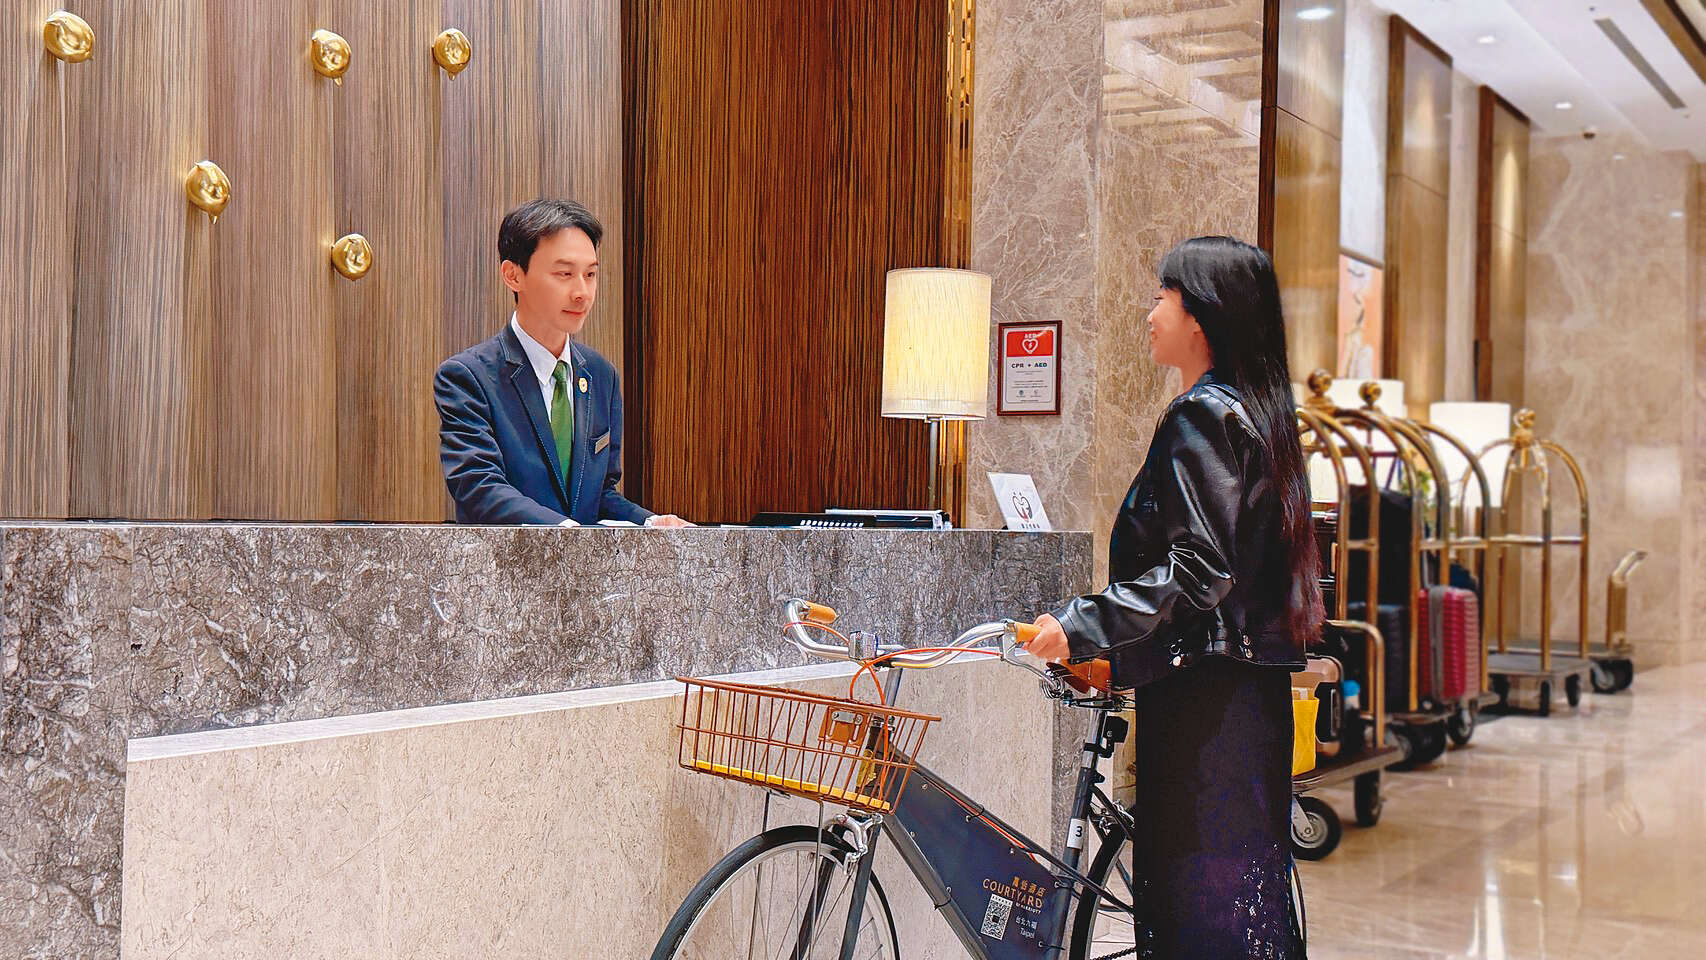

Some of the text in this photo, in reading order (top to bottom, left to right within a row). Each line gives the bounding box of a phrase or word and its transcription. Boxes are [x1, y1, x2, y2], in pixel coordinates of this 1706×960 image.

[1075, 825, 1083, 838] 3
[982, 878, 1043, 909] COURTYARD
[1019, 927, 1036, 939] Taipei
